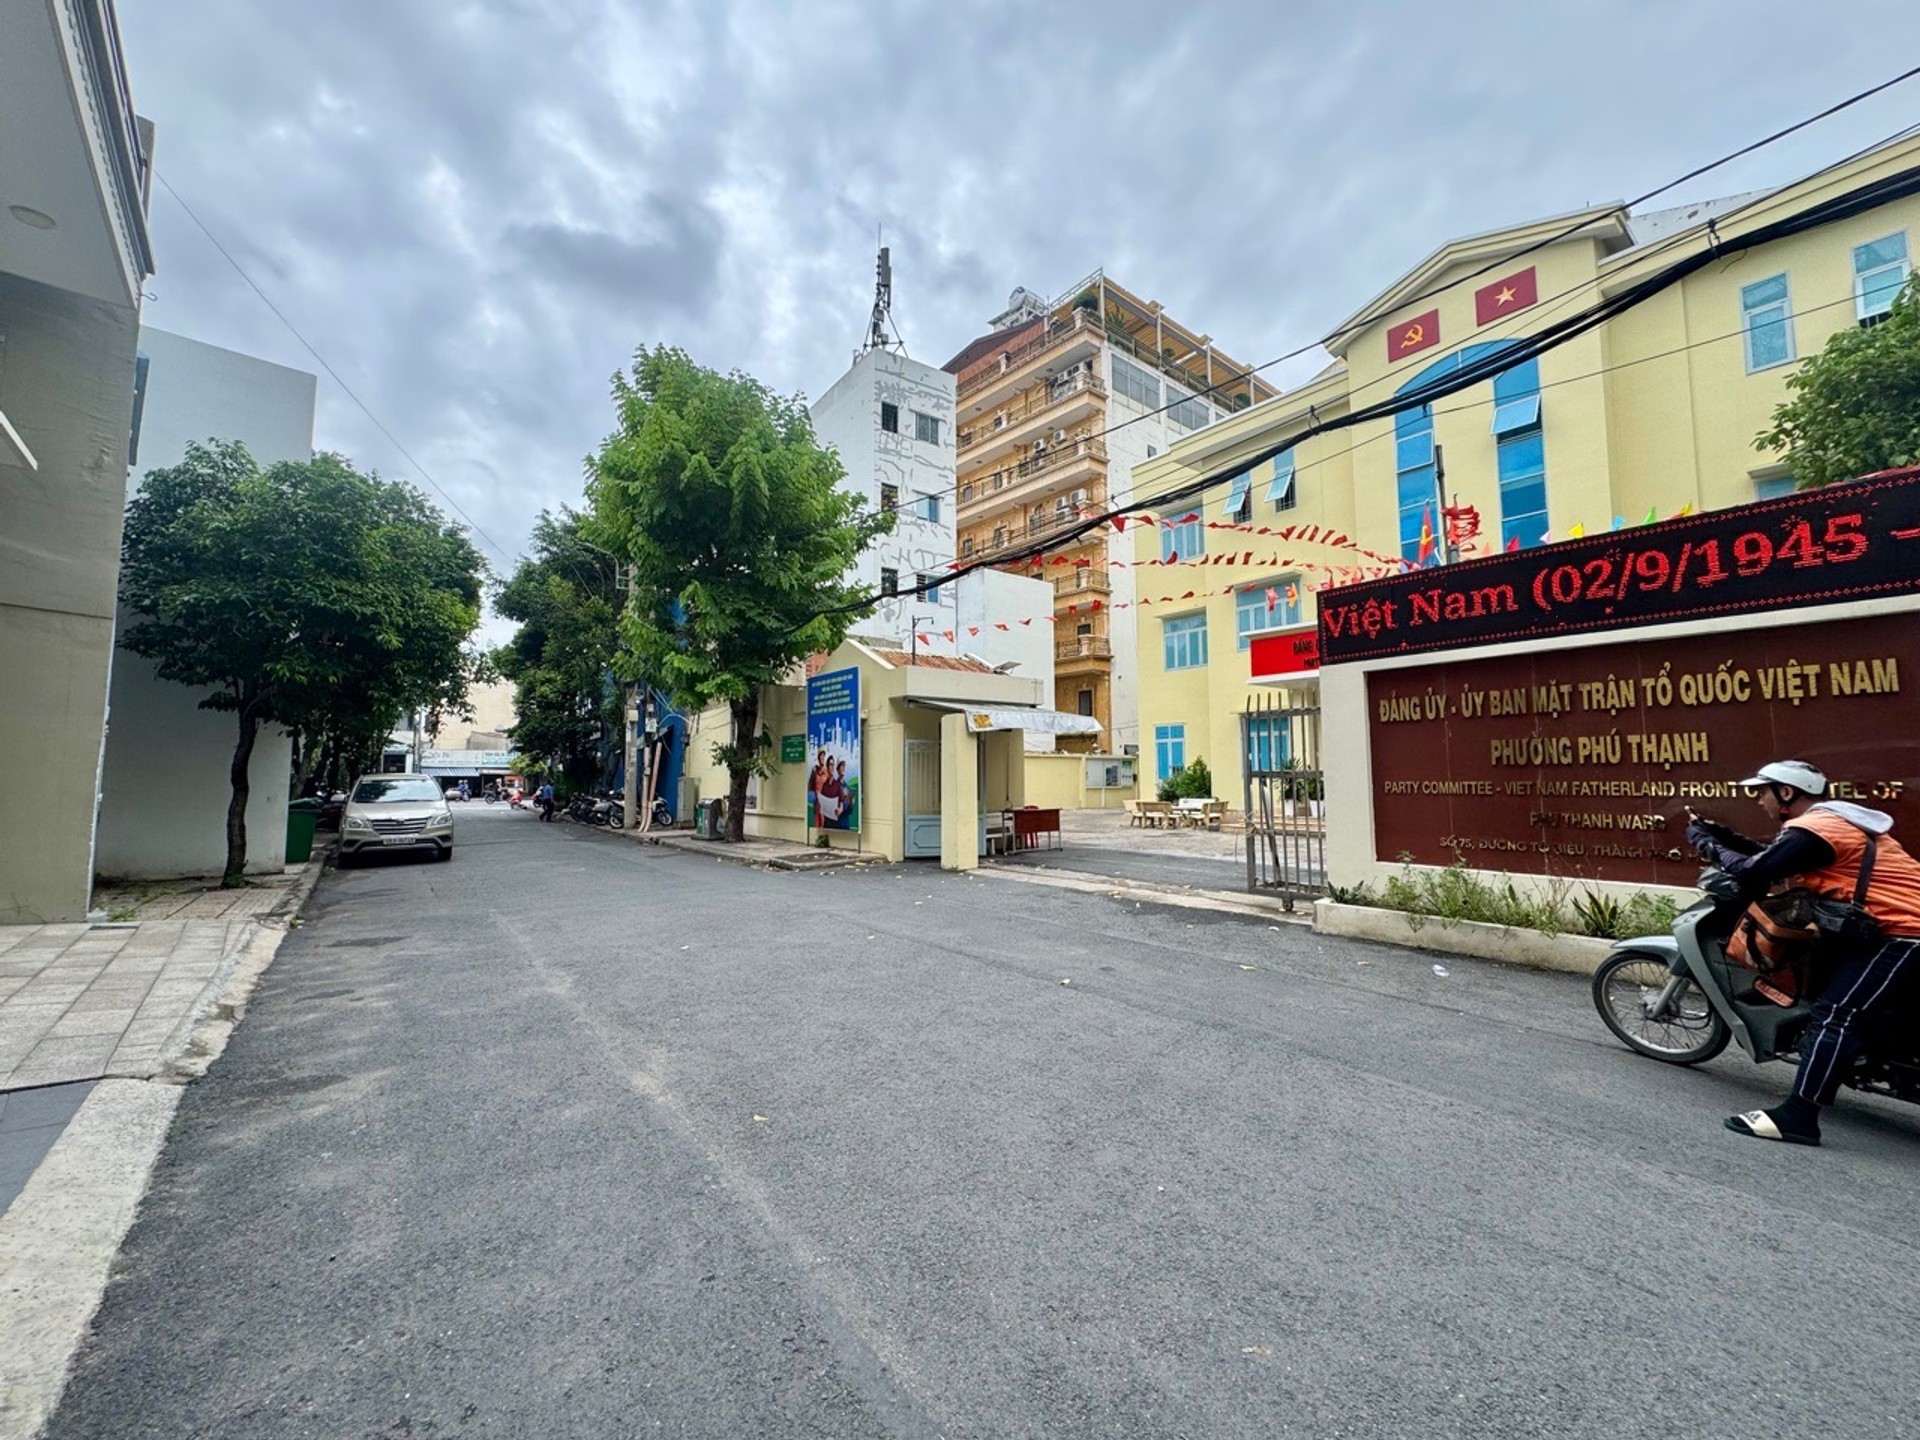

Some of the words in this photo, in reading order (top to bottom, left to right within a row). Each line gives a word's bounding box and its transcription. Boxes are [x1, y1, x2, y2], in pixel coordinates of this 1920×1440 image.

[1323, 597, 1398, 639] Việt
[1408, 583, 1519, 627] Nam
[1532, 514, 1869, 611] (02/9/1945
[1379, 689, 1422, 723] ĐẢNG
[1424, 686, 1448, 720] ỦY
[1460, 683, 1485, 718] ỦY
[1489, 688, 1527, 716] BAN
[1532, 679, 1573, 719] MẶT
[1578, 674, 1636, 717] TRẬN
[1641, 661, 1673, 707] TỔ
[1679, 659, 1751, 707] QUỐC
[1756, 659, 1821, 706] VIỆT
[1829, 657, 1900, 696] NAM
[1490, 729, 1574, 766] PHƯỜNG
[1577, 728, 1622, 765] PHÚ
[1626, 732, 1710, 771] THẠNH
[1384, 781, 1420, 795] PARTY
[1421, 781, 1493, 795] COMMITTEE
[1504, 781, 1532, 795] VIET
[1537, 780, 1568, 796] NAM
[1571, 781, 1676, 797] FATHERLAND
[1679, 781, 1737, 798] FRONT
